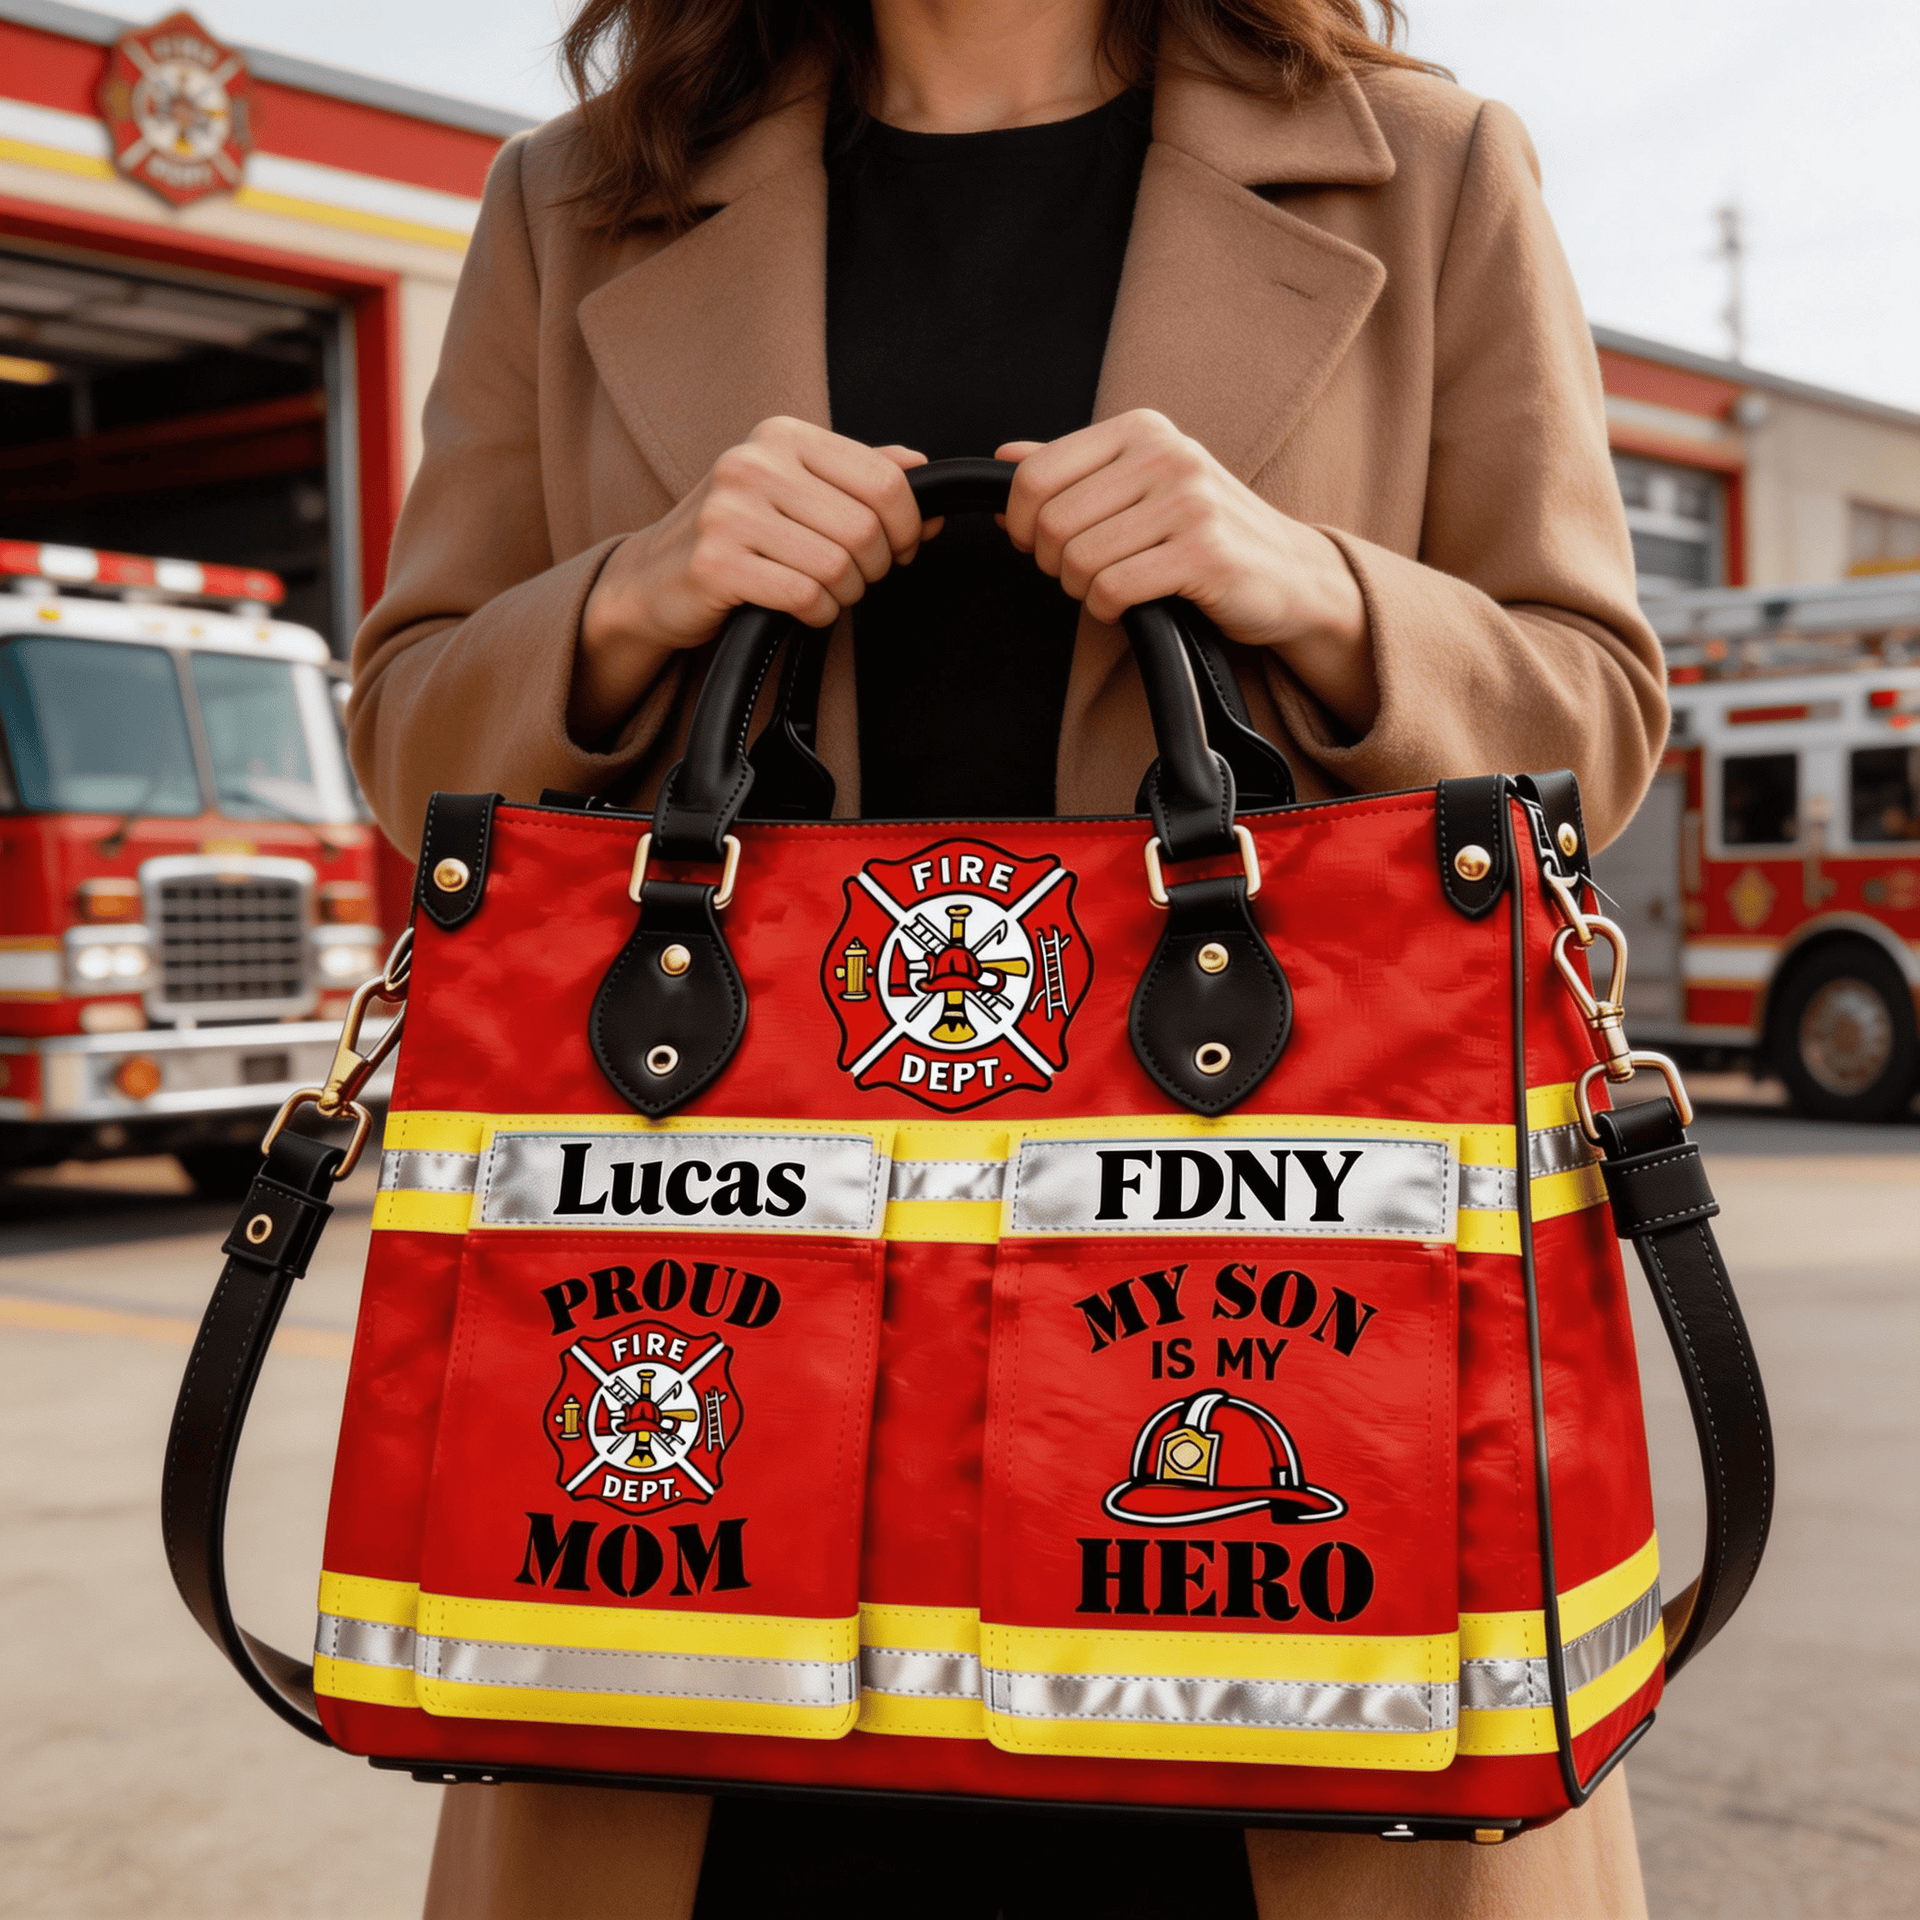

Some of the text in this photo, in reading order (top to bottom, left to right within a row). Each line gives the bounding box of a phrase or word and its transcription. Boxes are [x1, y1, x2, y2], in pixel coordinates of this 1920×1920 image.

[911, 855, 1014, 892] FIRE
[900, 1054, 1013, 1092] DEPT.
[552, 1142, 807, 1217] Lucas
[1094, 1149, 1364, 1222] FDNY
[540, 1259, 782, 1336] PROUD
[1073, 1263, 1378, 1357] MY SON
[611, 1332, 688, 1362] FIRE
[1151, 1338, 1289, 1380] IS MY
[602, 1474, 682, 1503] DEPT.
[514, 1511, 752, 1597] MOM
[1075, 1538, 1374, 1622] HERO
